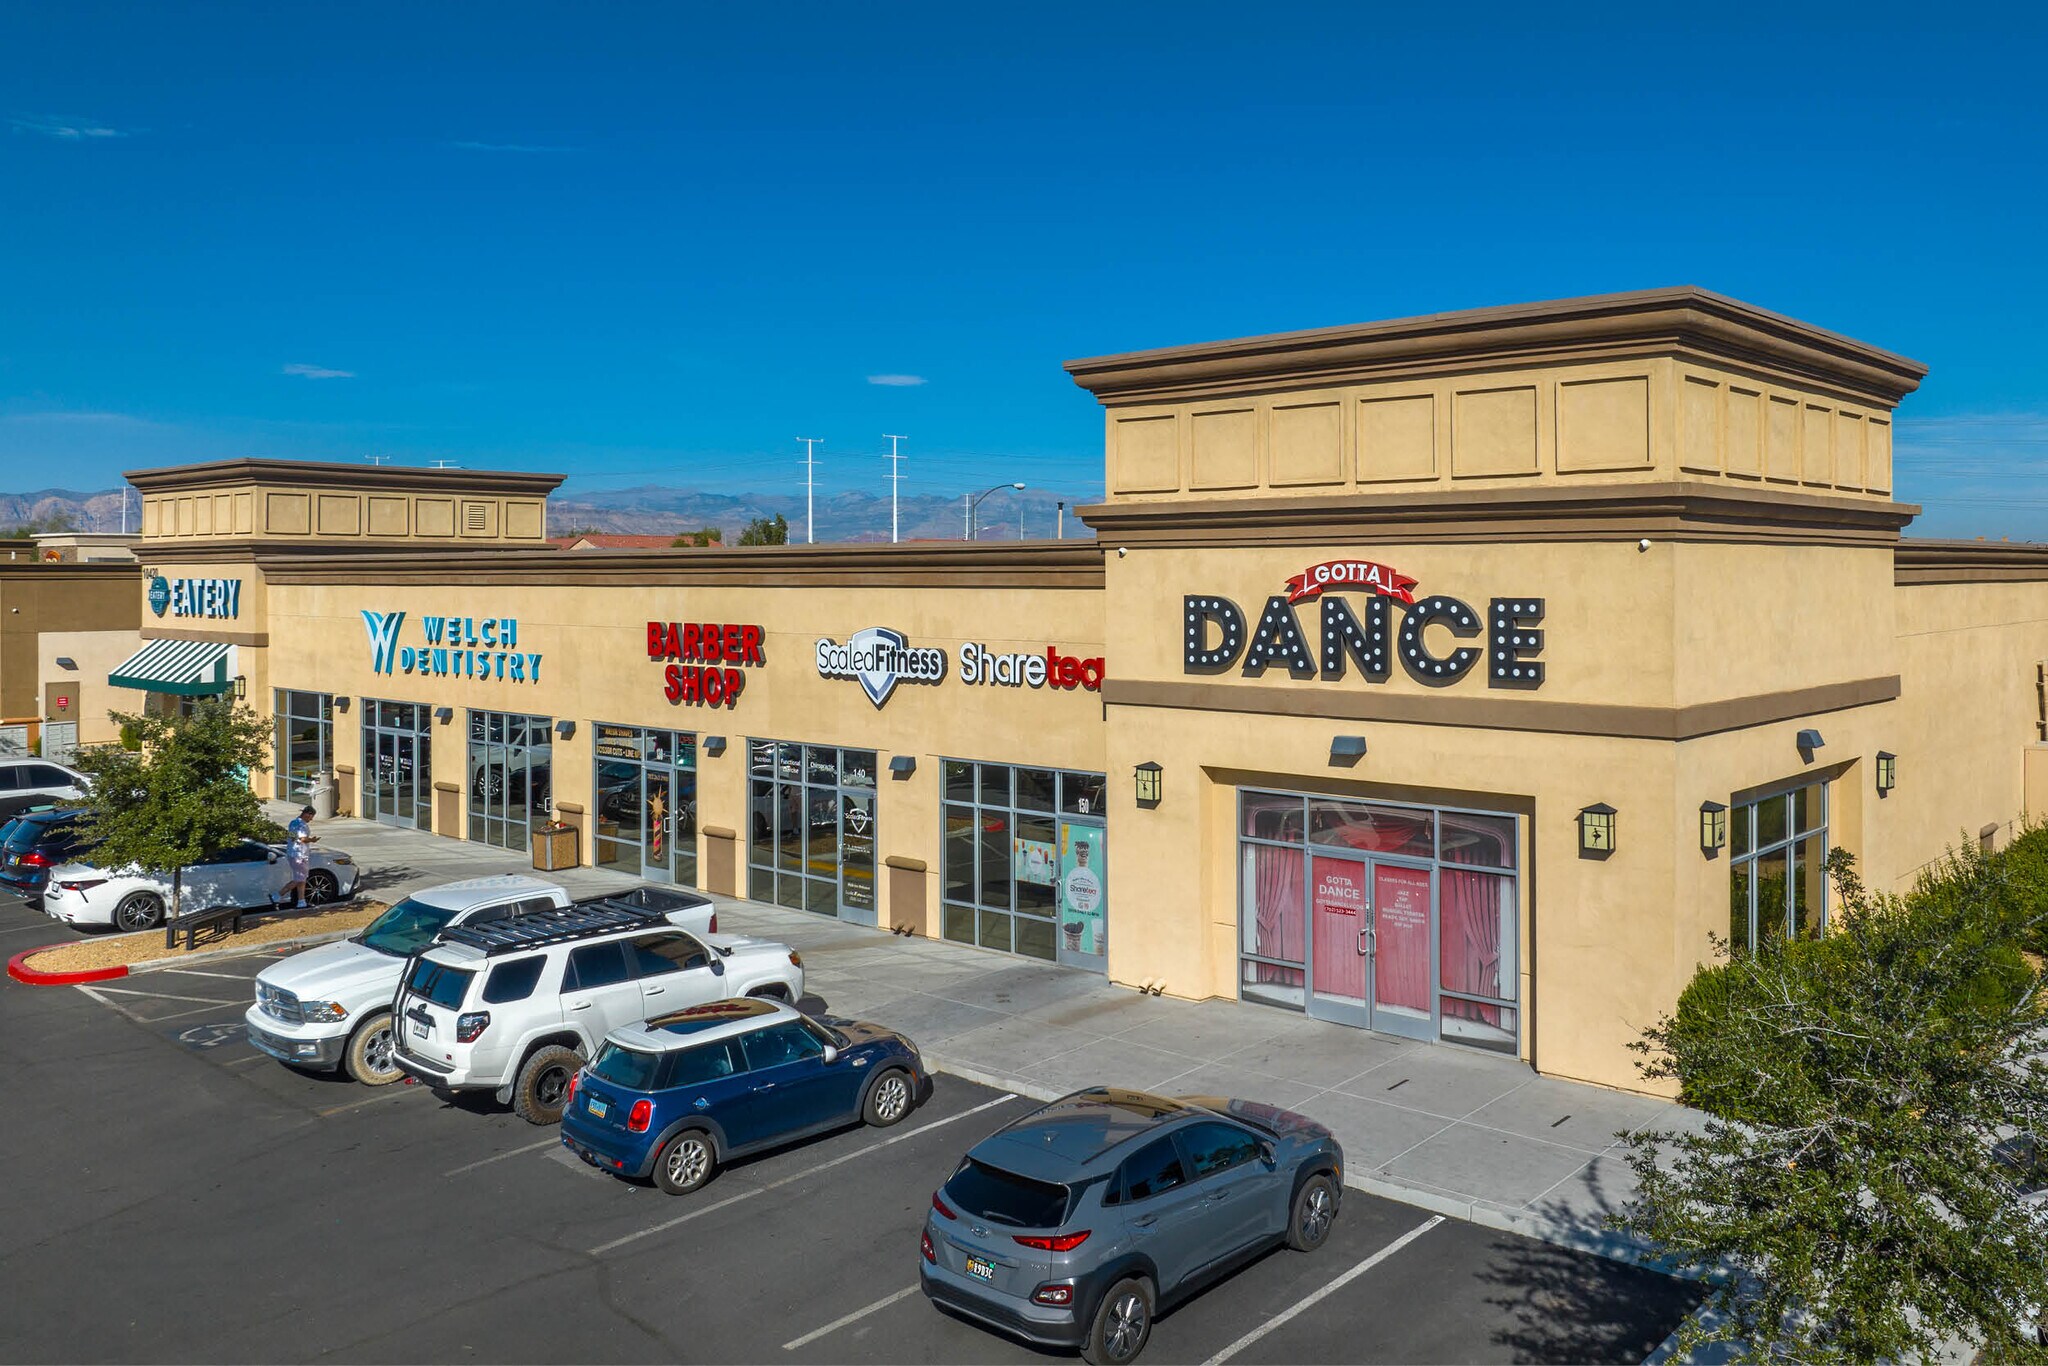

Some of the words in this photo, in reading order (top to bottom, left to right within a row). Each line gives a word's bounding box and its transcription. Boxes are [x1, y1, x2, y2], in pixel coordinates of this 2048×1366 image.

[1314, 564, 1381, 584] GOTTA
[171, 578, 241, 619] EATERY
[422, 616, 517, 649] WELCH
[647, 621, 767, 668] BARBER
[1184, 594, 1545, 690] DANCE
[401, 646, 543, 685] DENTISTRY
[818, 642, 941, 676] ScaledFitness
[959, 641, 1105, 692] Sharetea
[664, 664, 746, 710] SHOP
[853, 768, 866, 779] 140
[1078, 798, 1090, 814] 150
[1319, 884, 1361, 900] DANCE
[1326, 875, 1353, 887] GOTTA
